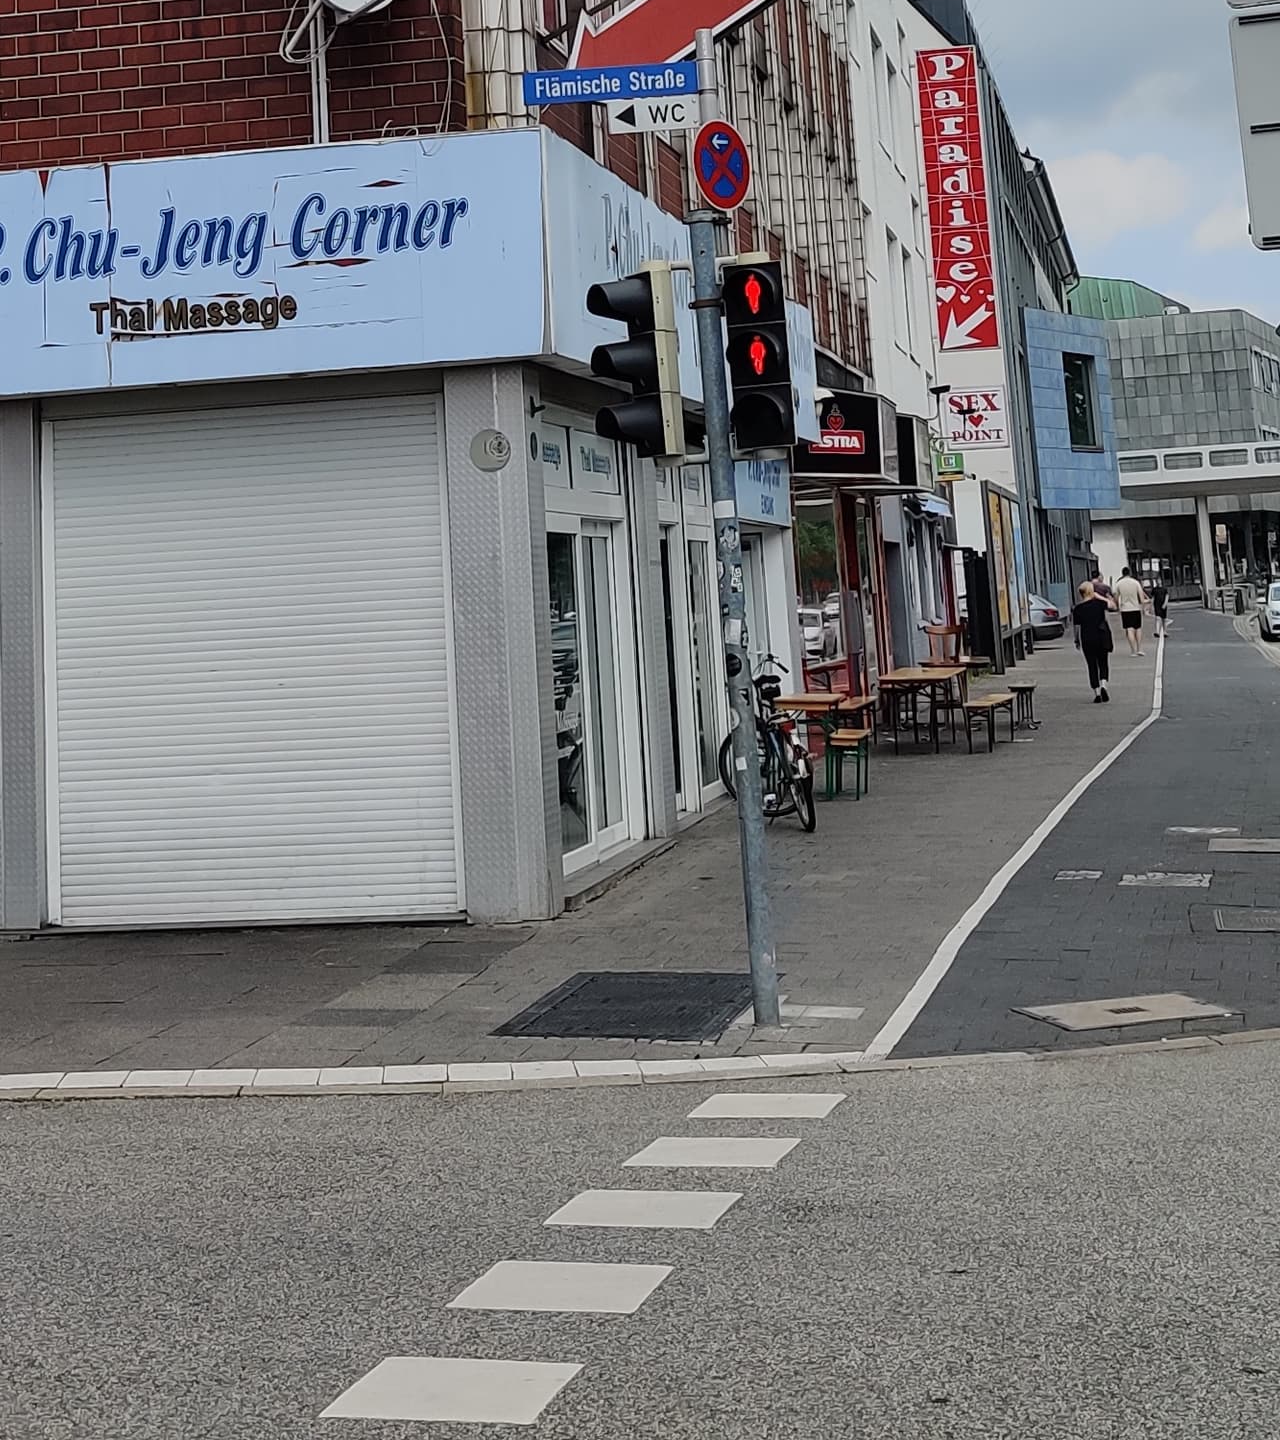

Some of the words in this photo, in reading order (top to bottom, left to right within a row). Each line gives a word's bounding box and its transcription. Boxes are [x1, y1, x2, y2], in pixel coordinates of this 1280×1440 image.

[535, 76, 620, 99] Flämische
[629, 68, 686, 91] Straße
[648, 103, 686, 124] WC
[927, 53, 979, 282] Paradise
[22, 205, 269, 287] Chu-Jeng
[289, 192, 469, 260] Corner
[89, 298, 153, 335] Thai
[163, 295, 298, 330] Massage
[948, 393, 1002, 414] SEX
[812, 435, 861, 449] STRA
[951, 428, 1004, 442] POINT
